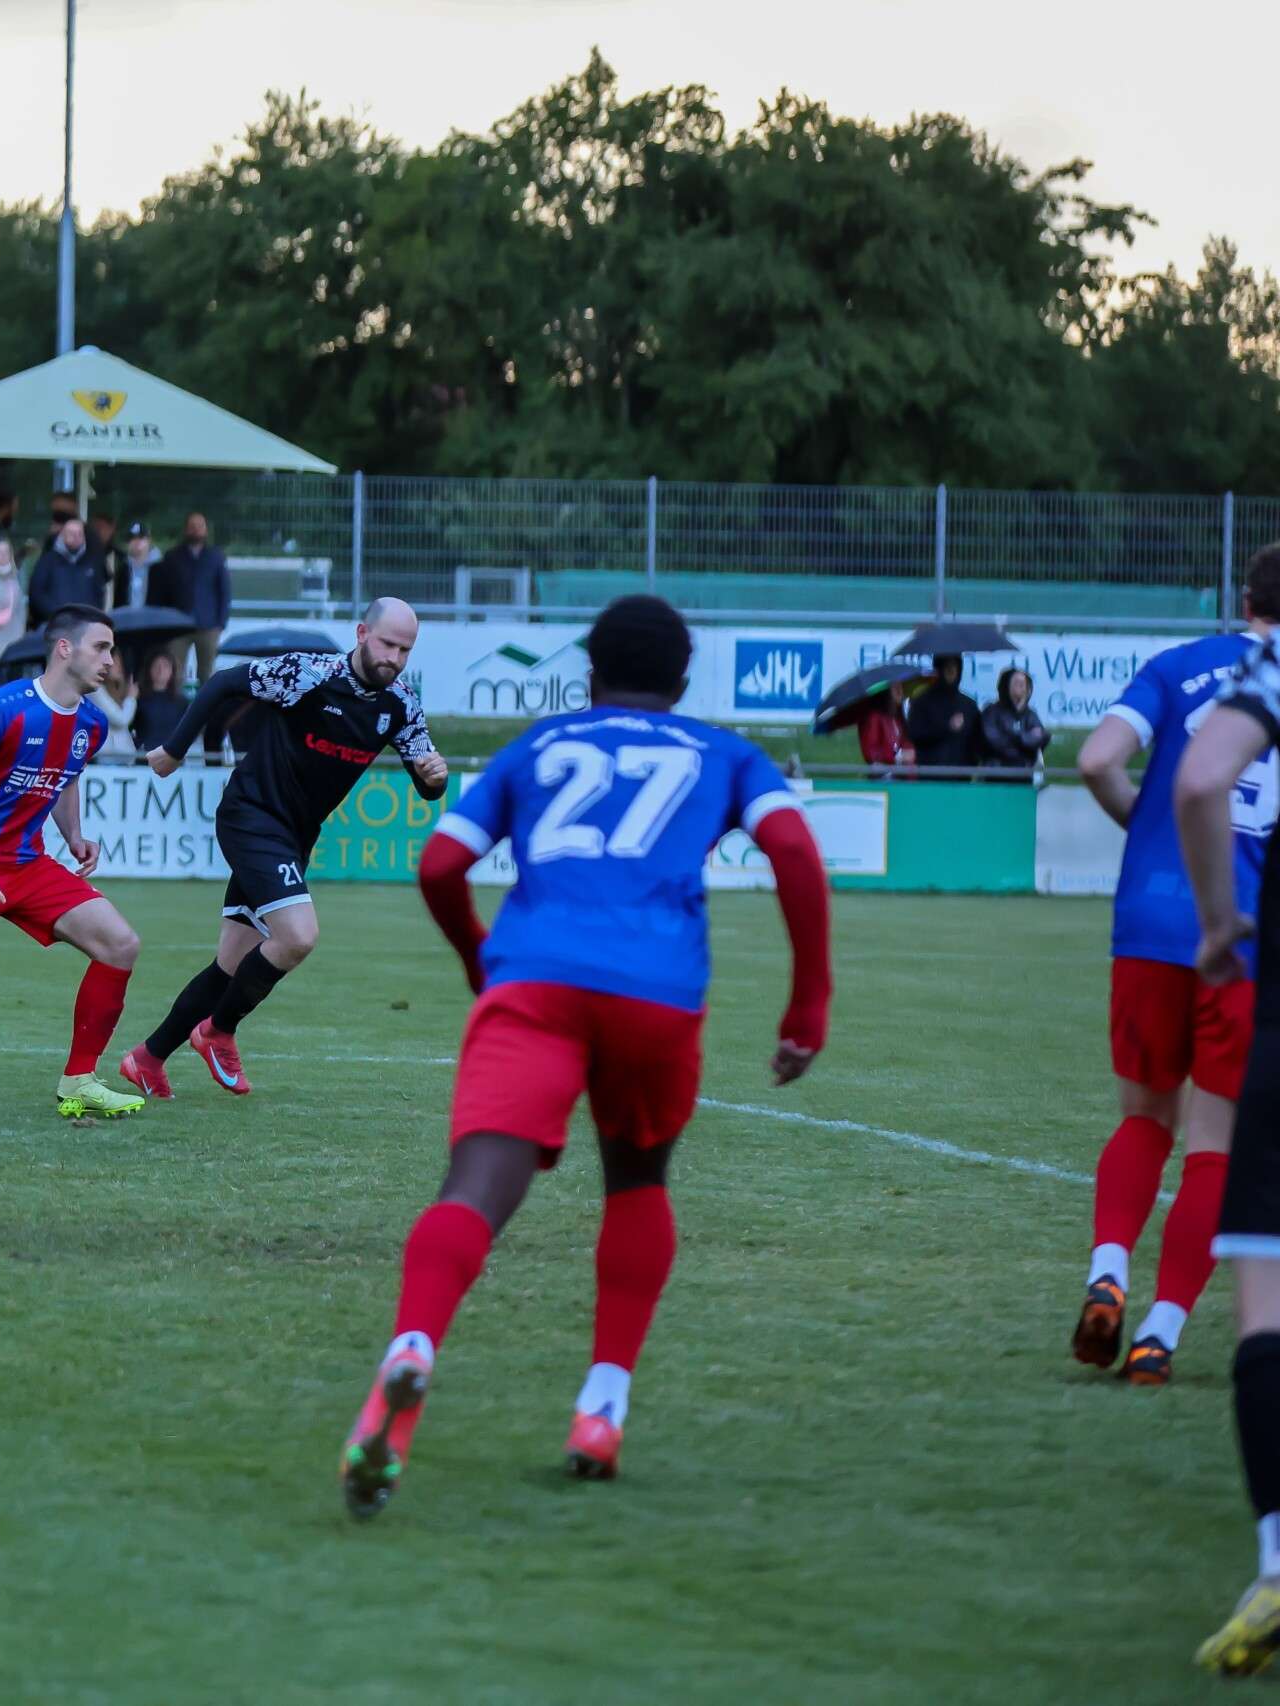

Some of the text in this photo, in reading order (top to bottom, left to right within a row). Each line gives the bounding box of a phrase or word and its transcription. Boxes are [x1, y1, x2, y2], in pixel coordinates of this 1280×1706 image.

[50, 420, 163, 441] GANTER
[526, 739, 703, 866] 27
[277, 862, 304, 887] 21
